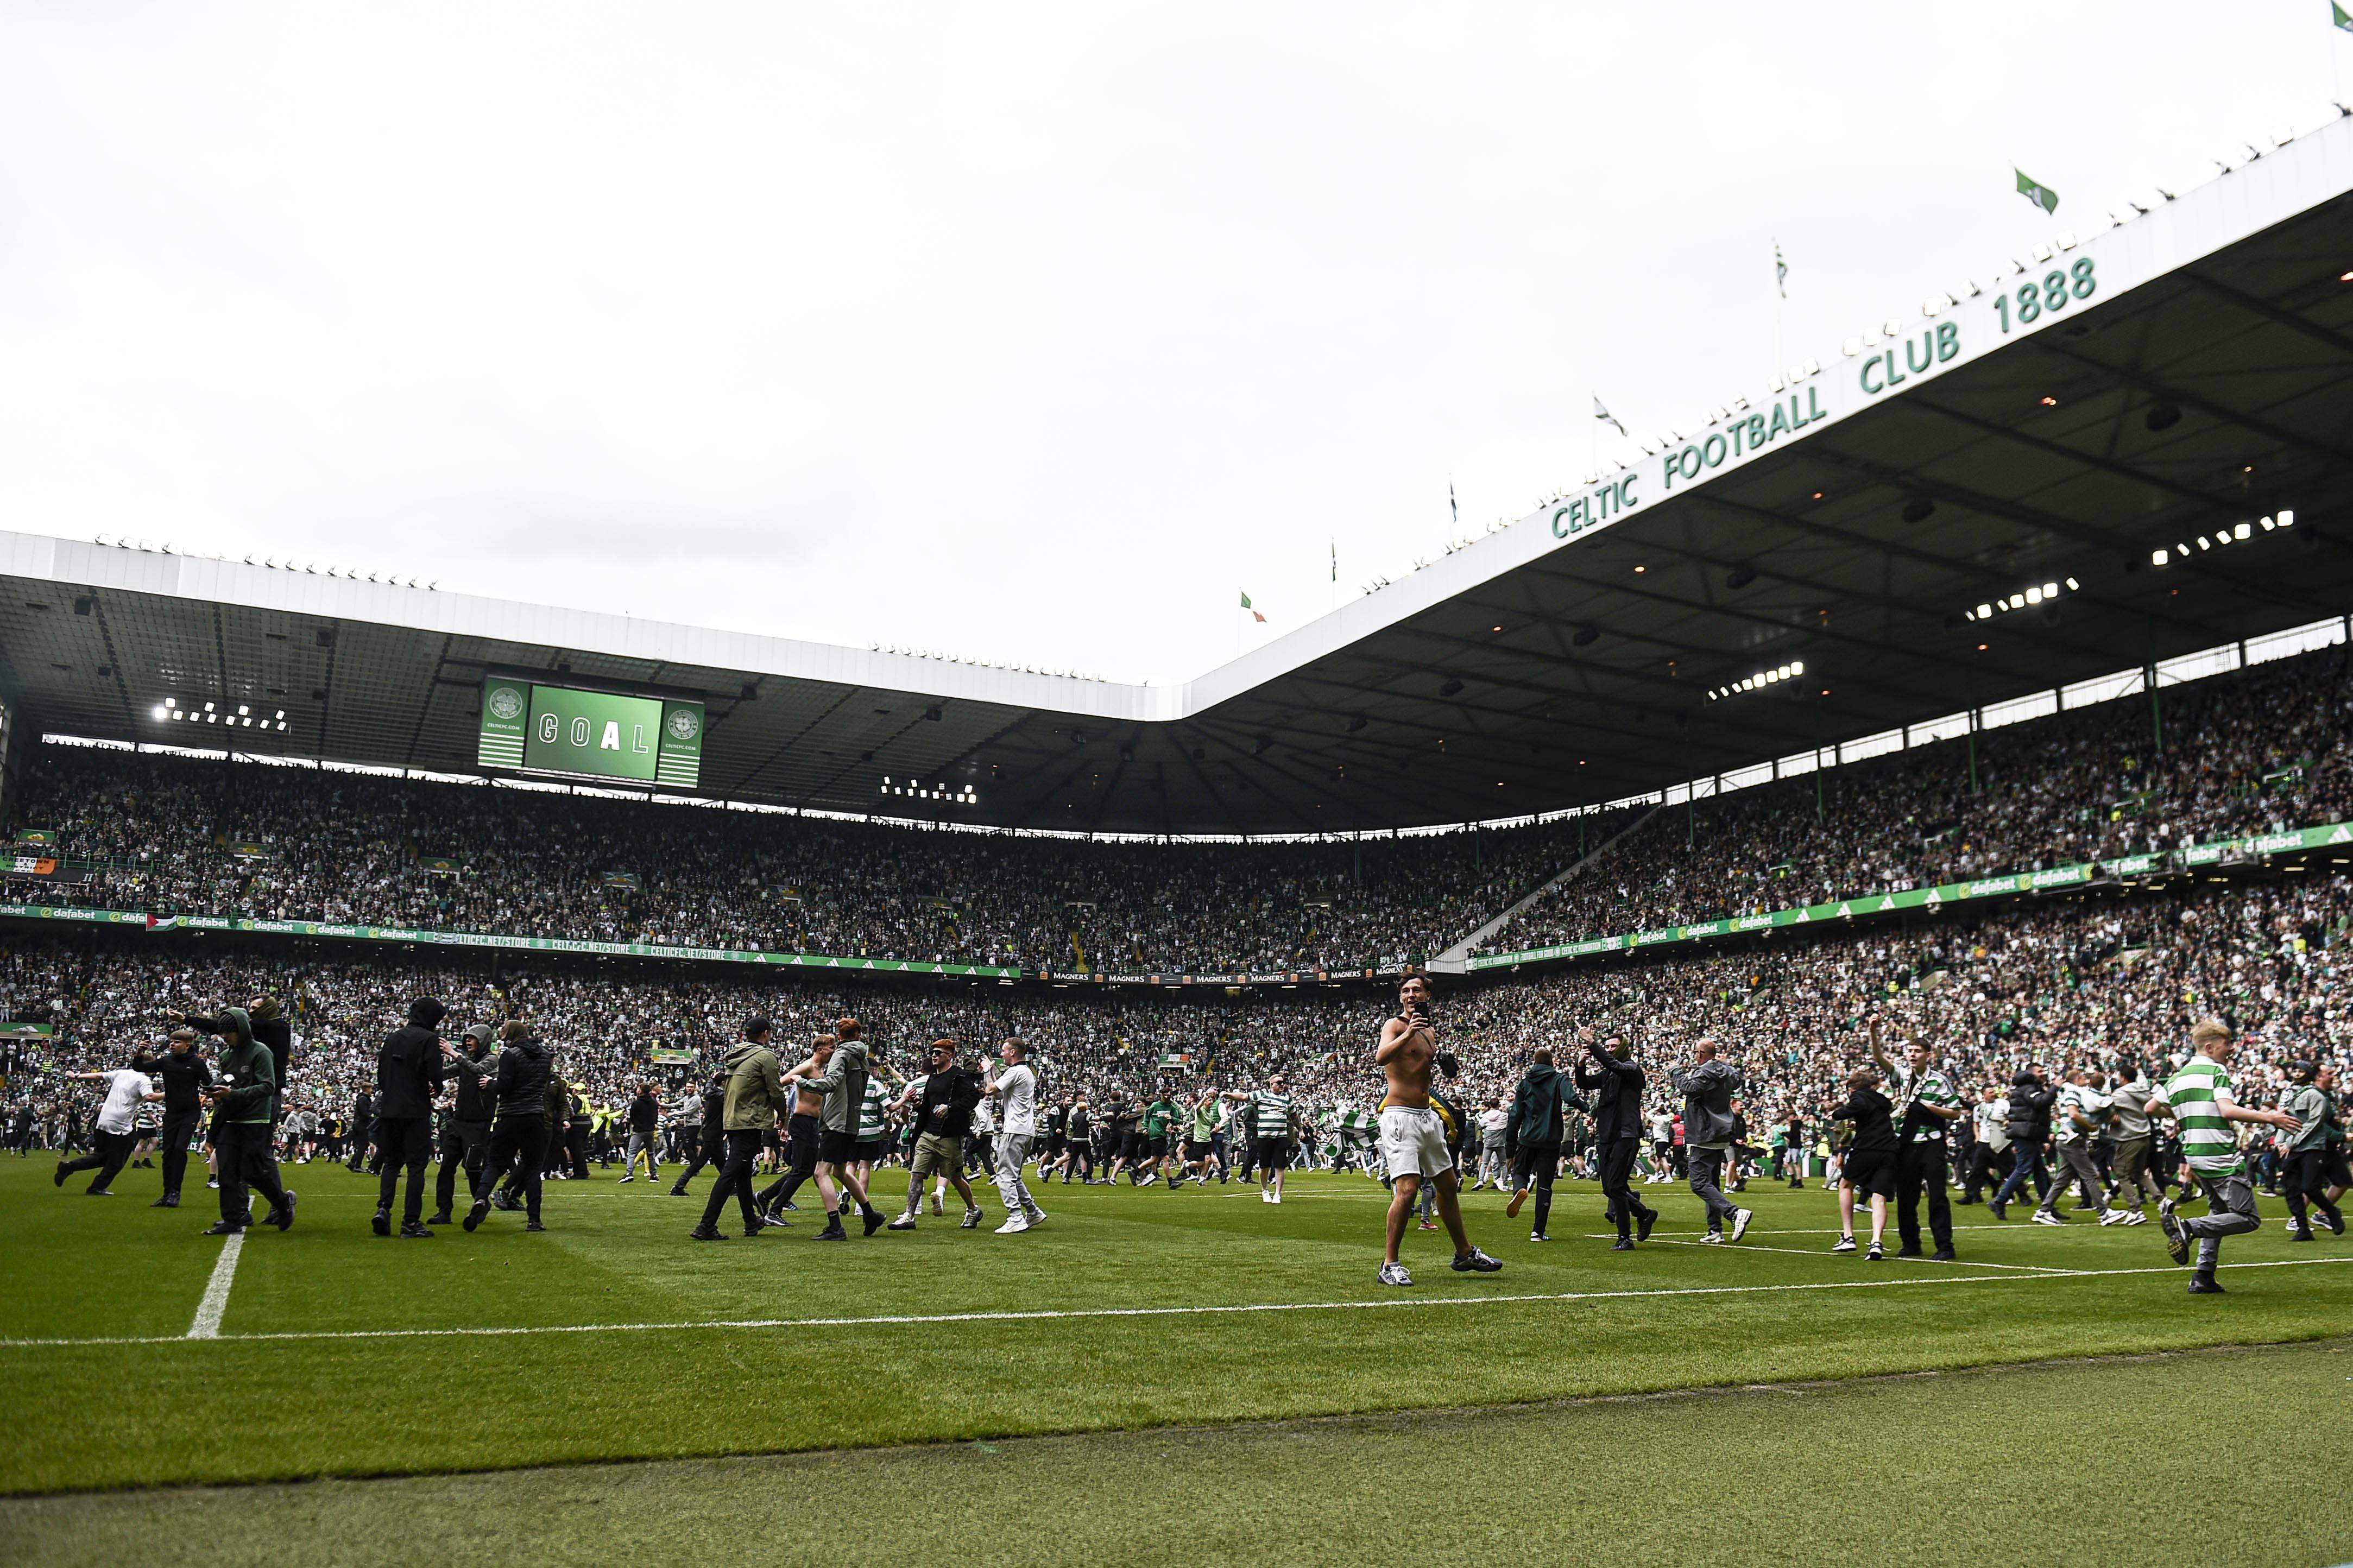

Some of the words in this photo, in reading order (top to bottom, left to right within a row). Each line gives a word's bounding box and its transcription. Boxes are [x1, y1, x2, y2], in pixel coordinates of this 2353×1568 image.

[1551, 474, 1638, 538] CELTIC
[1664, 387, 1827, 489] FOOTBALL
[1860, 321, 1960, 394] CLUB
[1995, 257, 2097, 333] 1888
[539, 713, 649, 754] GOAL
[2033, 868, 2080, 886] dafabet
[1971, 878, 2016, 895] dafabet
[53, 907, 96, 919] dafabet
[188, 917, 229, 927] dafabet
[254, 920, 293, 931] dafabet
[1739, 915, 1772, 929] dafabet
[318, 925, 356, 935] dafabet
[380, 929, 417, 939] dafabet
[1687, 923, 1718, 937] dafabet
[459, 933, 531, 947] LTICFC.NET/STORE
[1638, 930, 1667, 944] dafabet
[1053, 972, 1089, 981] MAGNERS
[1330, 970, 1361, 979] MAGNERS
[1376, 966, 1399, 975] MAGNE
